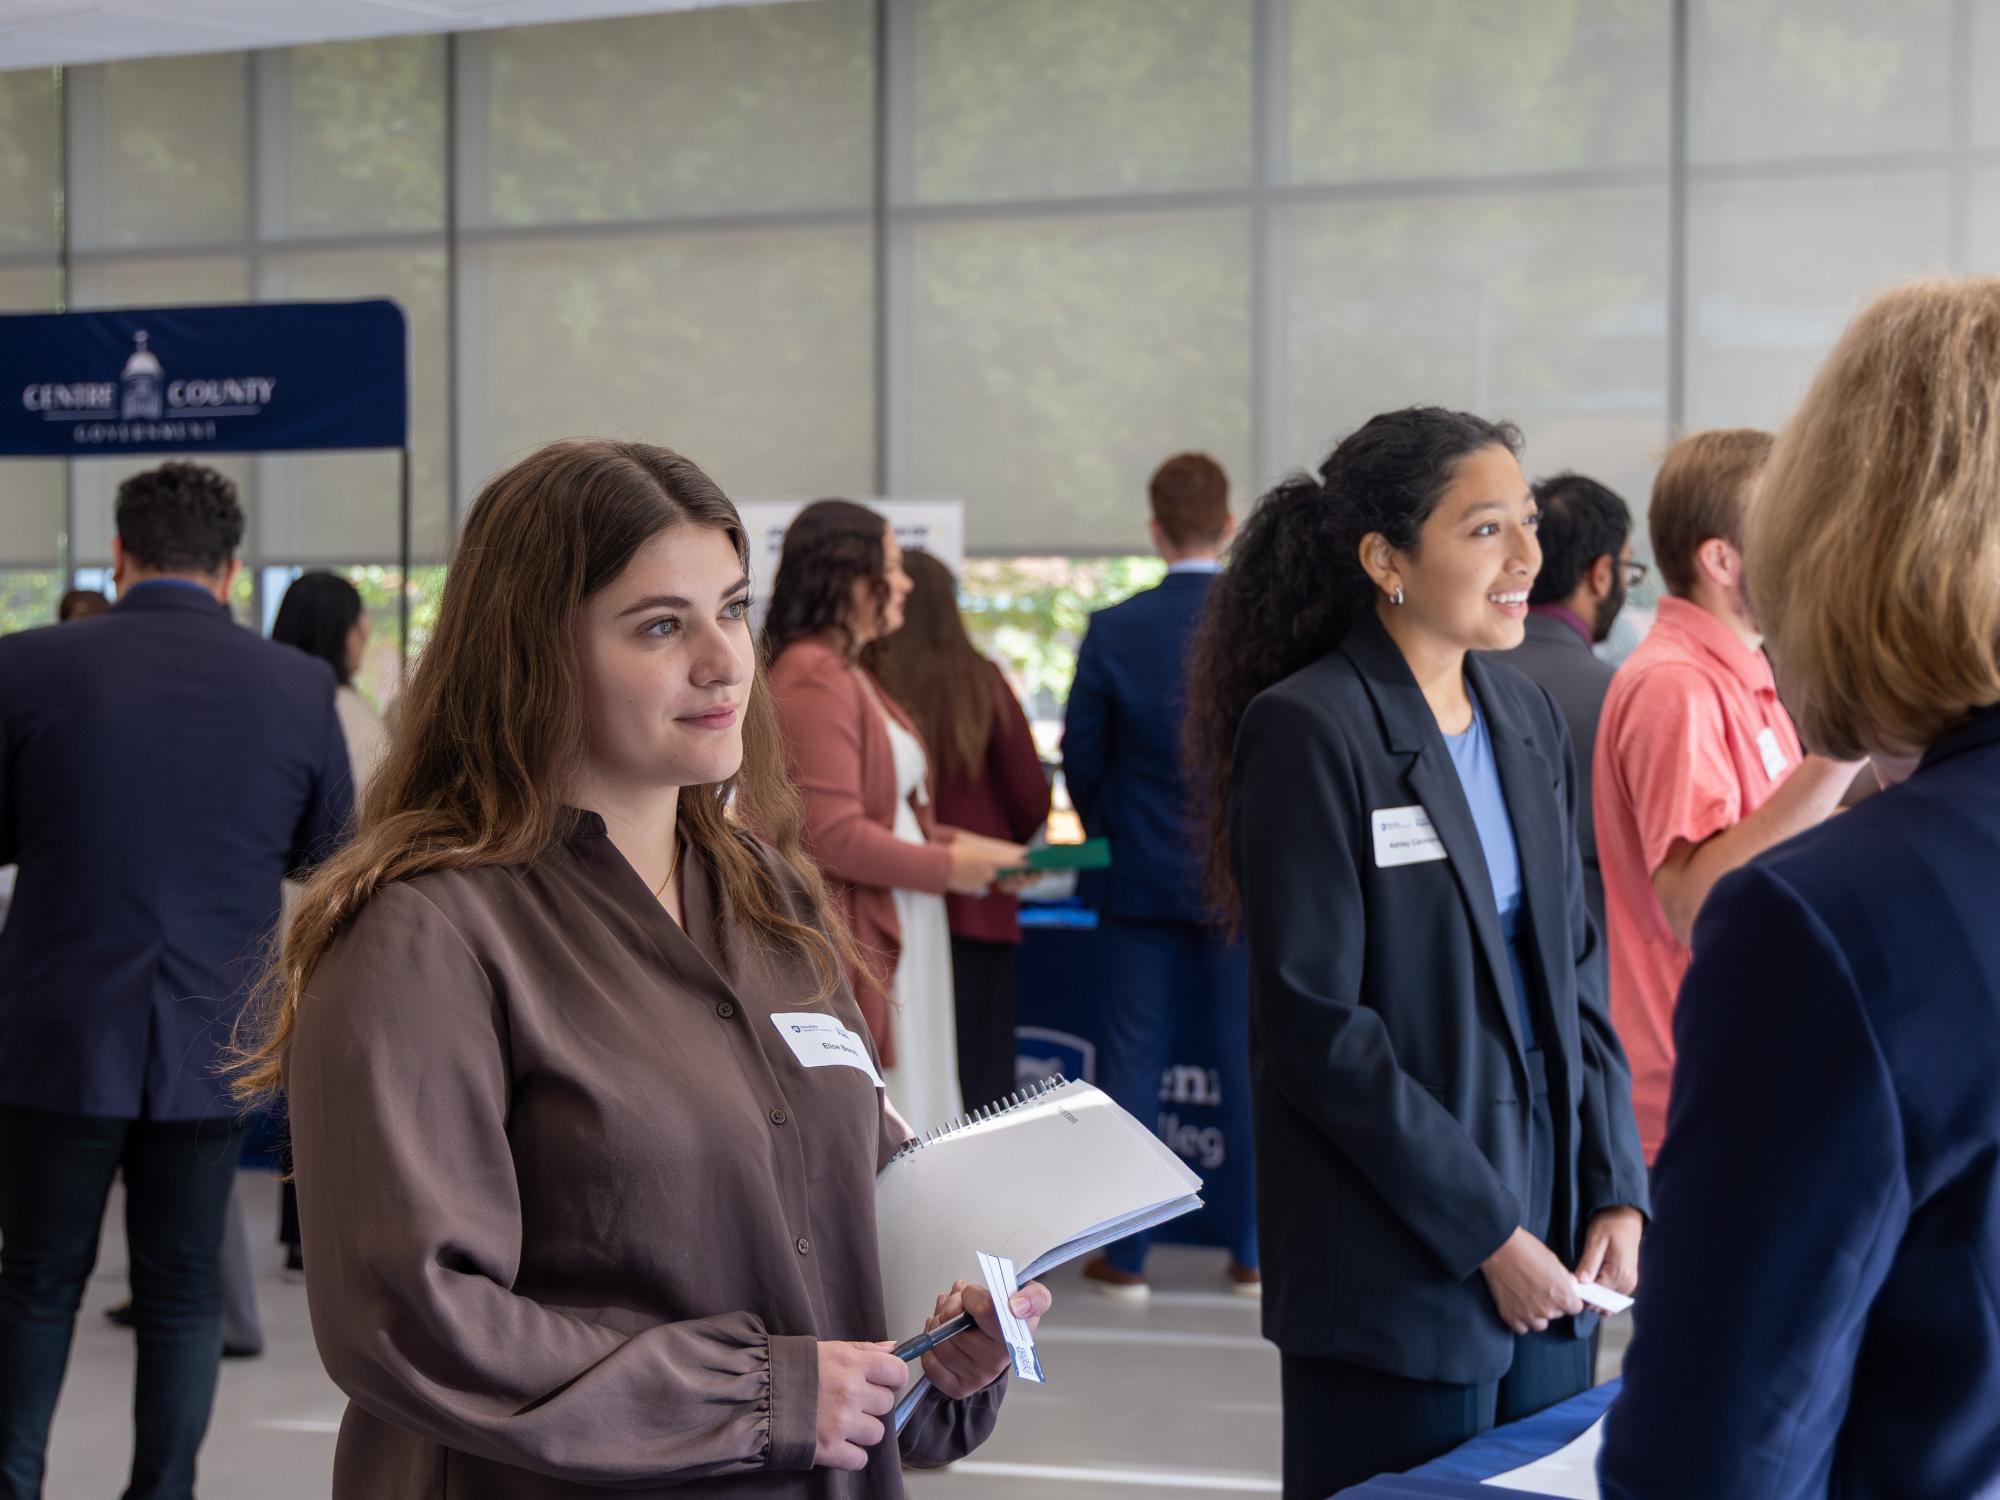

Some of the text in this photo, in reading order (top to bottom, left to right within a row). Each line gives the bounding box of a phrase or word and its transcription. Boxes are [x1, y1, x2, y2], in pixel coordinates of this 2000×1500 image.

[23, 376, 276, 412] CENTRE COUNTY
[73, 419, 217, 444] GOVERNMENT
